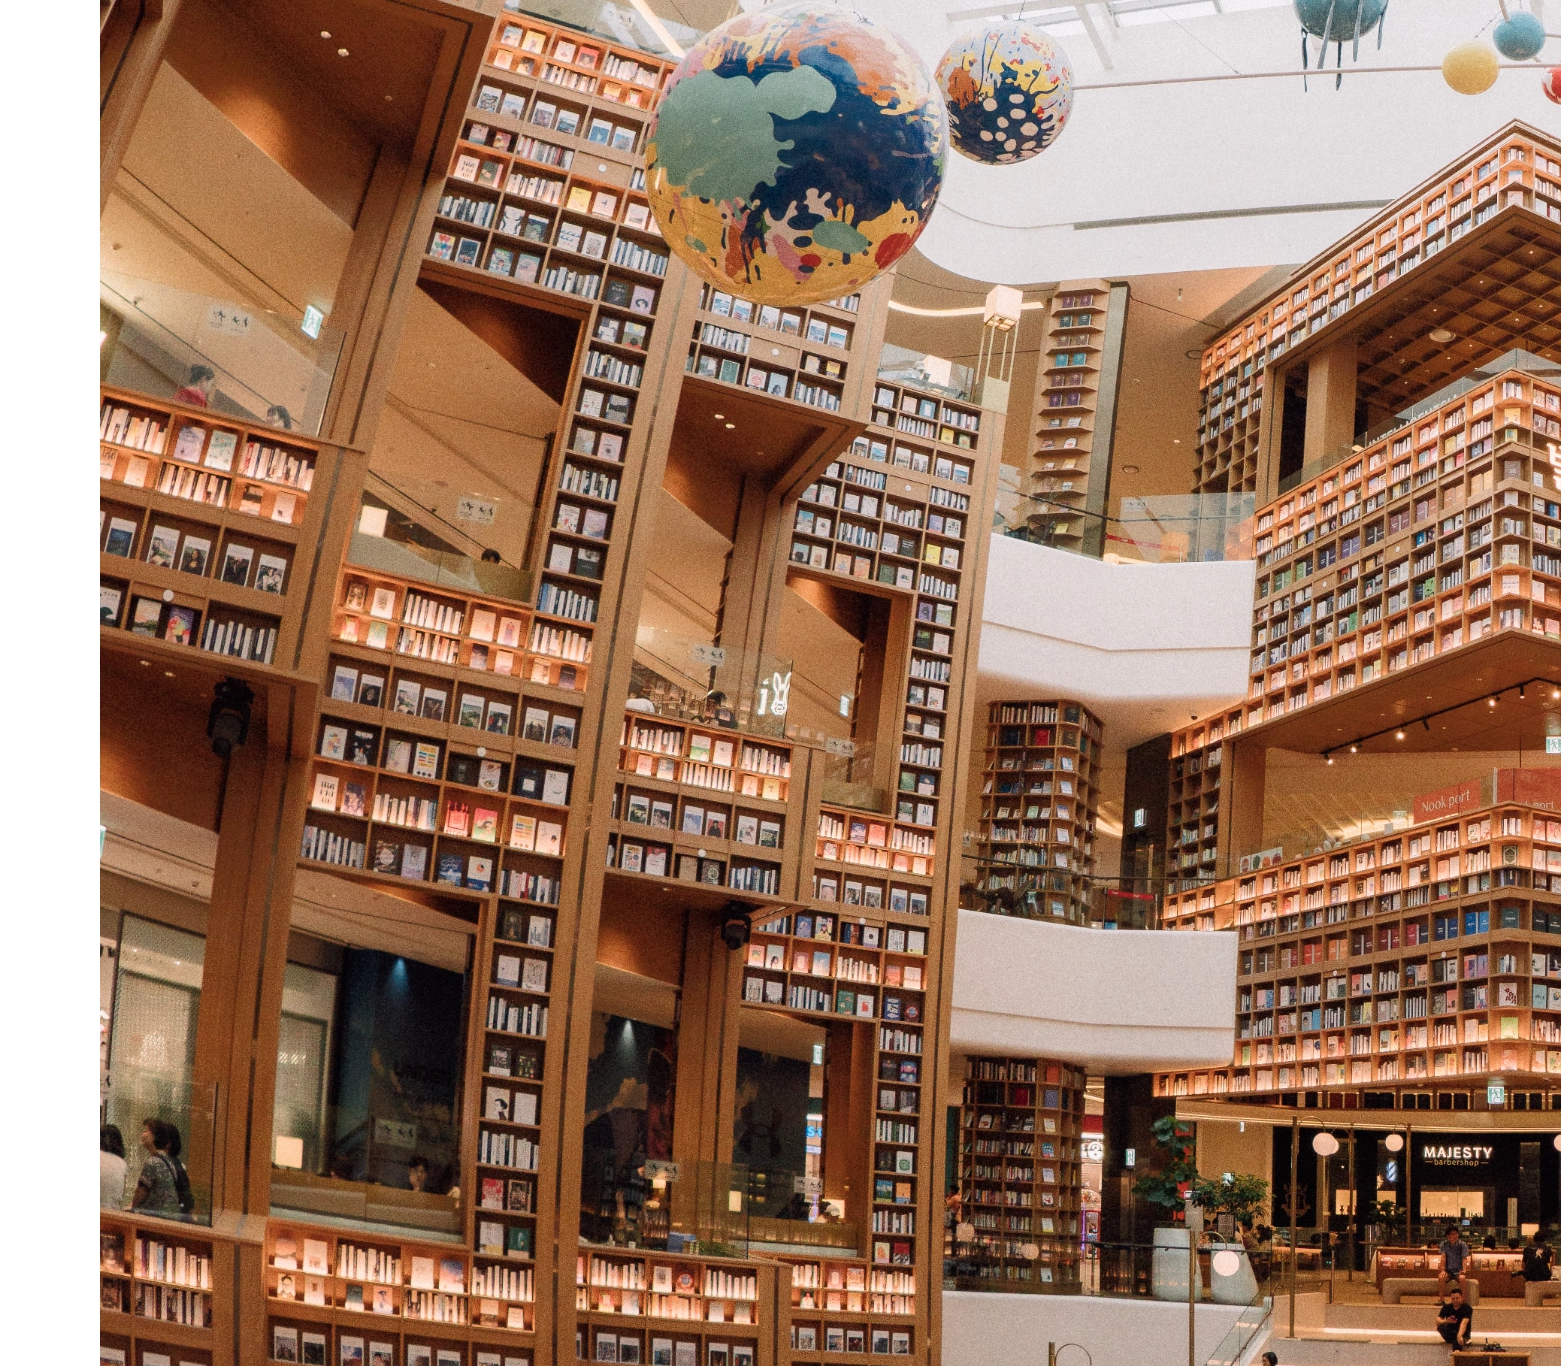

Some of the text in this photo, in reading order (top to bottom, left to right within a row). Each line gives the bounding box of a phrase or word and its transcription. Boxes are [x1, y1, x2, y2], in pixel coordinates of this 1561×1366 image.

[1421, 789, 1471, 814] Nook port
[1424, 1146, 1493, 1159] MAJESTY
[1433, 1158, 1480, 1167] barbershop
